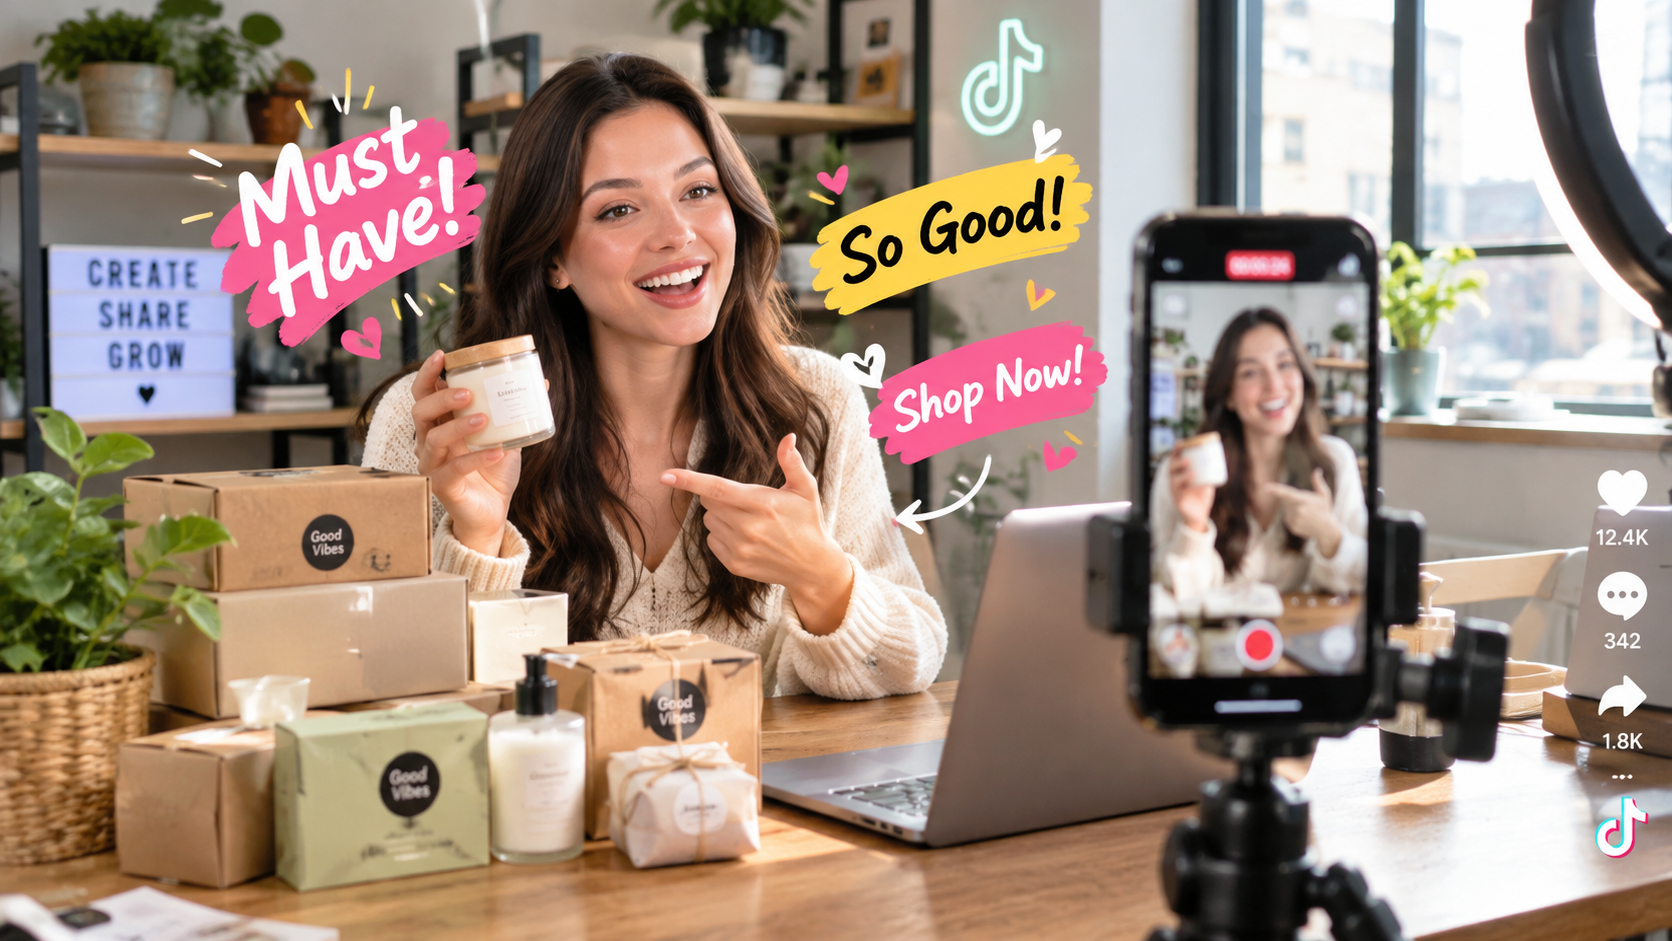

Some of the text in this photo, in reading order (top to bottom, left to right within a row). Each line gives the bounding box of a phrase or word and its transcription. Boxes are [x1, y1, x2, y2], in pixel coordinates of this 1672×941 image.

[88, 259, 198, 289] CREATE
[99, 301, 190, 328] SHARE
[108, 341, 184, 368] GROW
[310, 528, 343, 543] Good
[312, 543, 345, 557] Vibes
[657, 694, 693, 711] Good
[659, 711, 696, 726] Vibes
[389, 765, 429, 786] Good
[391, 784, 431, 801] Vibes
